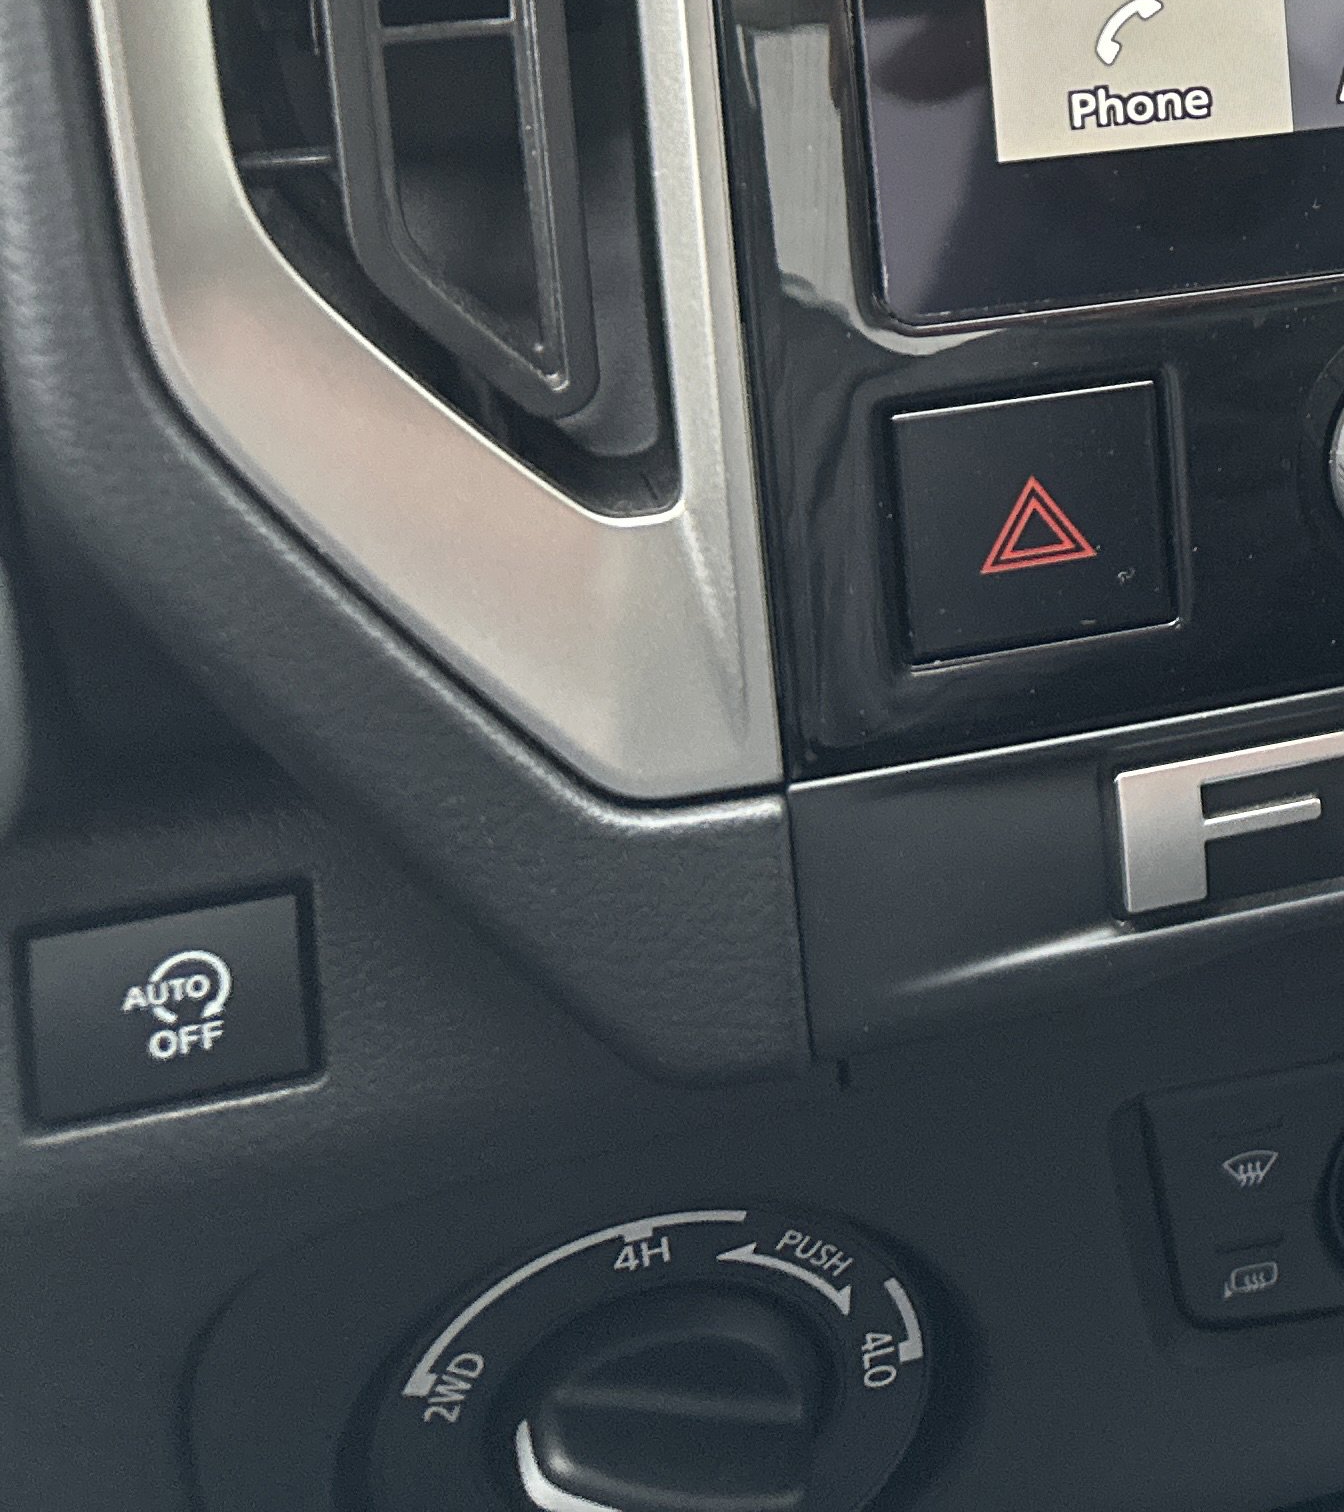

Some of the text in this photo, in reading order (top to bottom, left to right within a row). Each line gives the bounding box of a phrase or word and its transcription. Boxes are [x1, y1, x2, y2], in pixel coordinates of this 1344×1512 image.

[1069, 83, 1213, 131] Phone
[122, 974, 211, 1012] AUTO
[148, 1019, 225, 1061] OFF
[613, 1235, 672, 1274] 4H
[774, 1229, 854, 1279] PUSH
[858, 1330, 897, 1390] 4LO
[422, 1351, 487, 1425] 2WD
